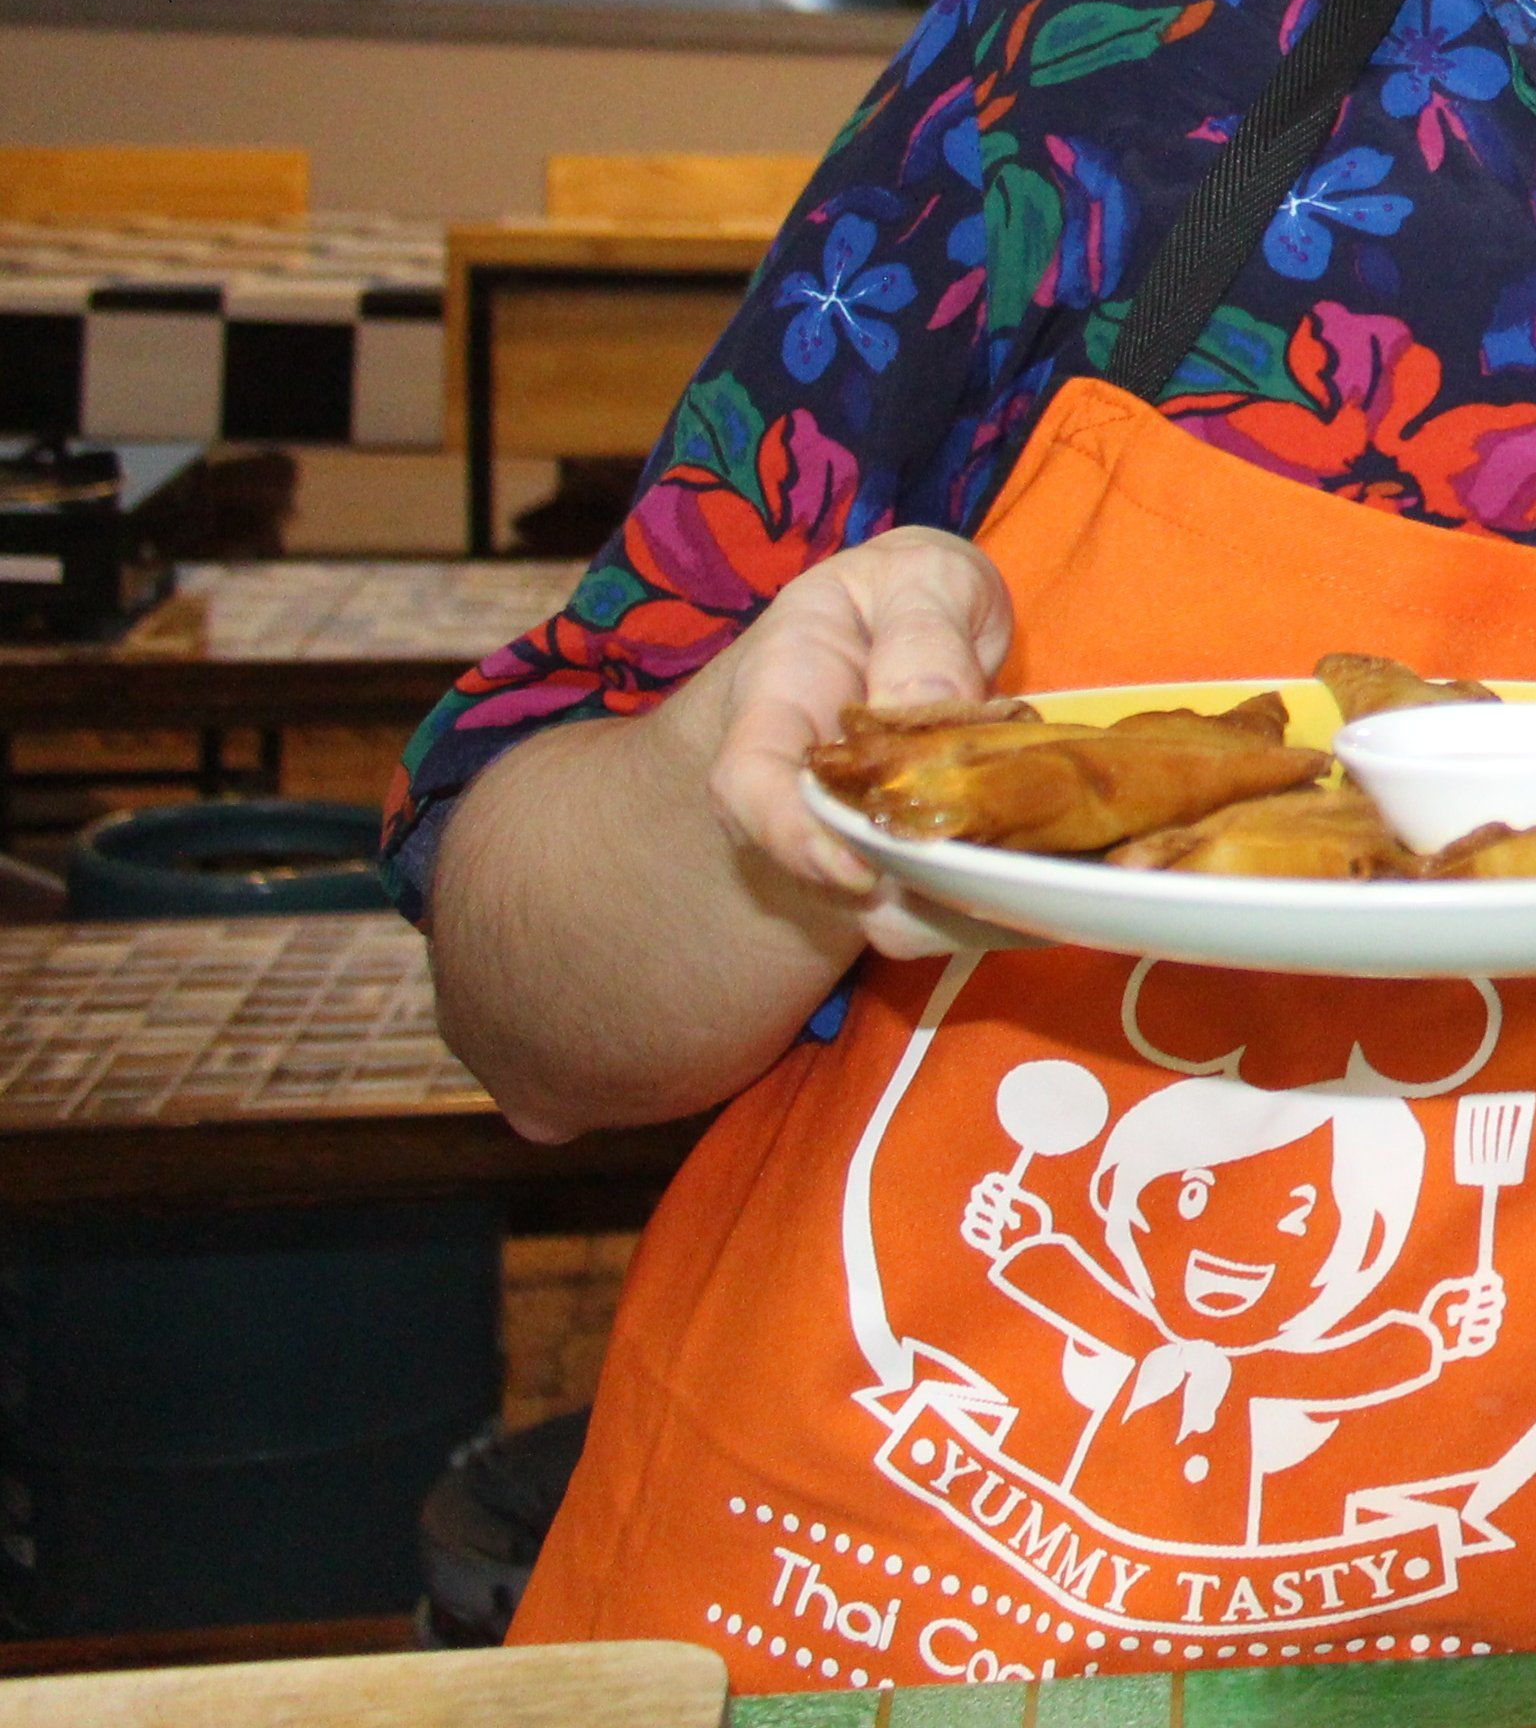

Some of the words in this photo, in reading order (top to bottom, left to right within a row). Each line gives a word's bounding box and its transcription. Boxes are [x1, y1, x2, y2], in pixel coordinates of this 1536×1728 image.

[772, 1546, 901, 1651] Thai
[929, 1437, 1151, 1614] YUMMY
[1176, 1548, 1399, 1622] TASTY
